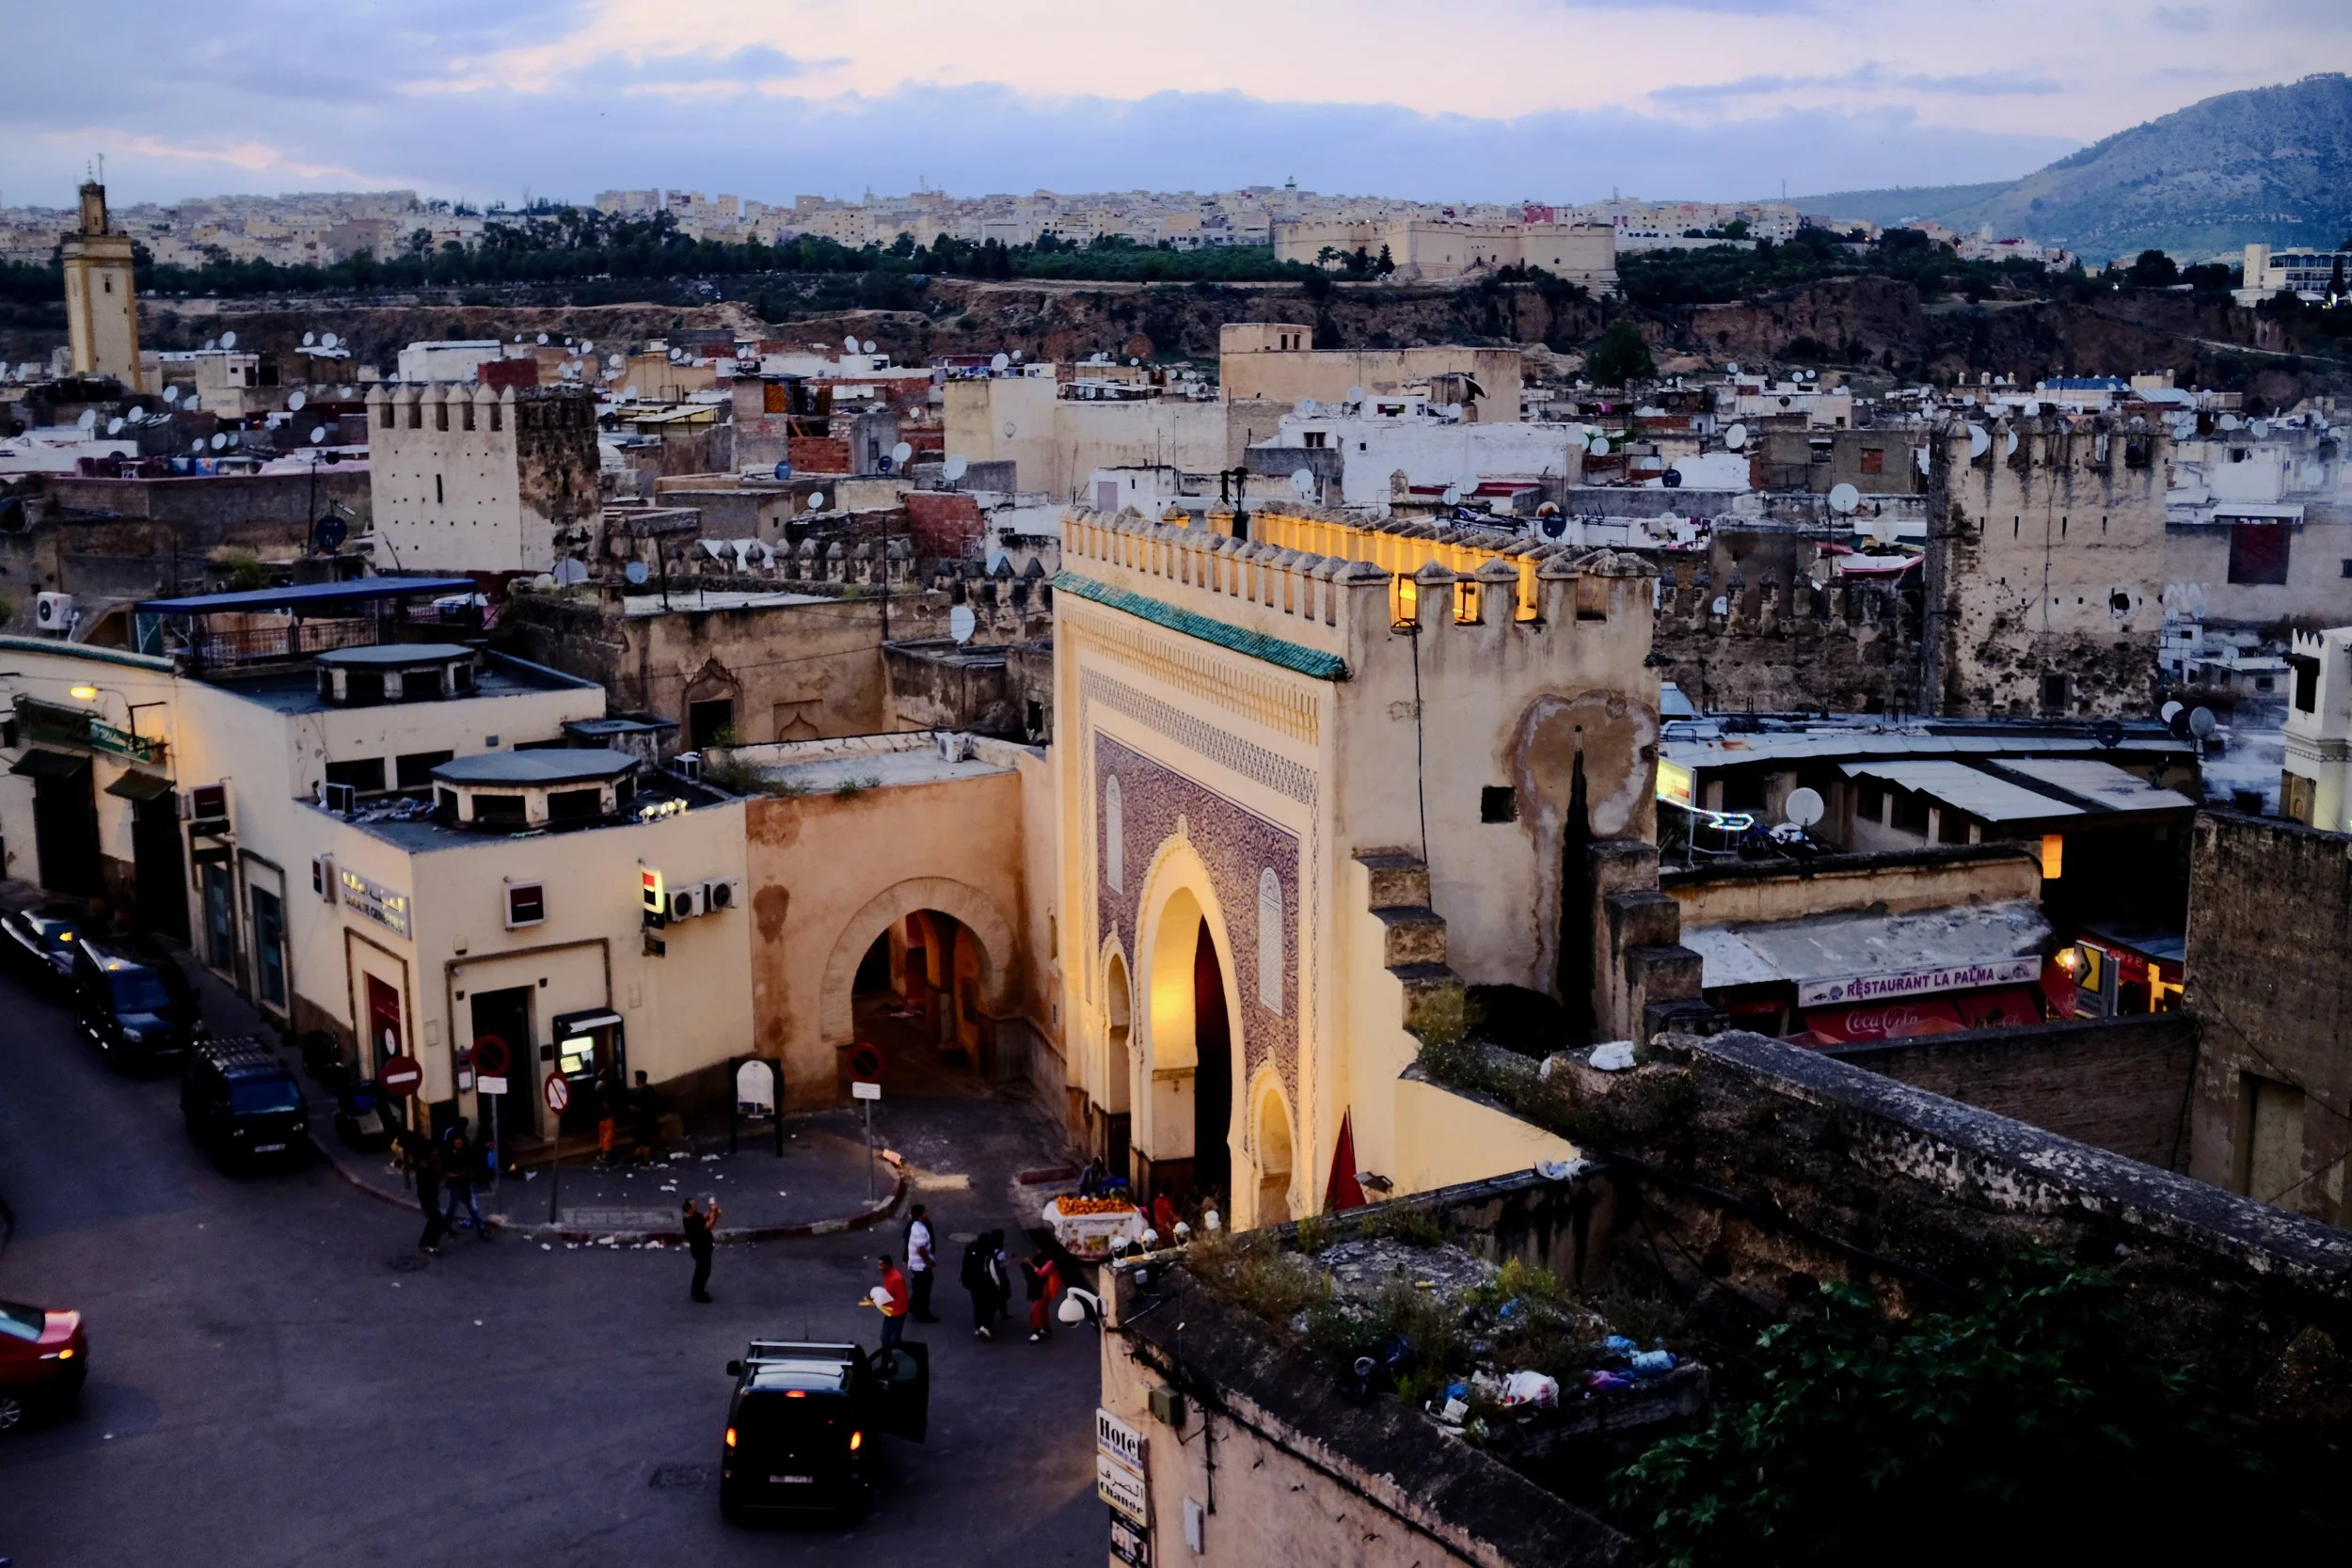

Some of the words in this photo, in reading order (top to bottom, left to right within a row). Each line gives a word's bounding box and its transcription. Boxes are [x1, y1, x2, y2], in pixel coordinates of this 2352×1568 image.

[1847, 975, 1930, 997] RESTAURANT
[1934, 973, 1950, 986] LA
[1954, 967, 1994, 985] PALMA
[1099, 1416, 1142, 1461] Hotel
[1100, 1481, 1143, 1514] Change
